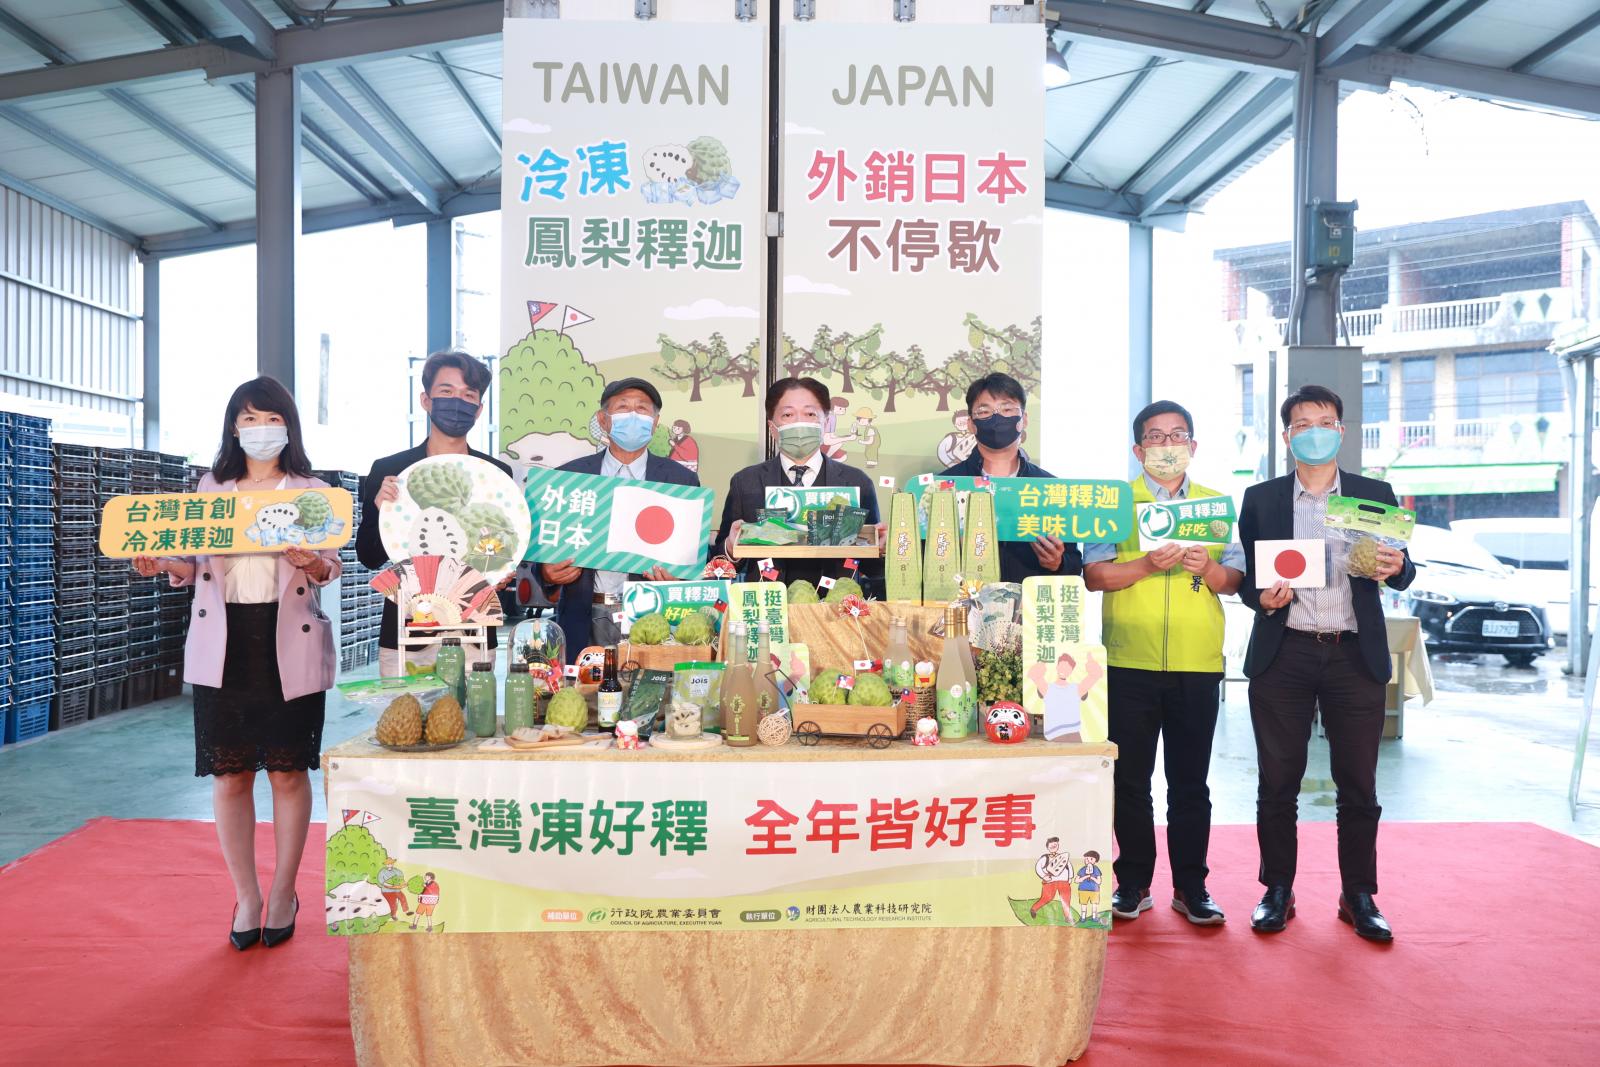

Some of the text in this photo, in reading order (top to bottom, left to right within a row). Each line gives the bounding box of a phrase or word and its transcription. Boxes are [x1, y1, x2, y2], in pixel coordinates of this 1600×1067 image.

[533, 61, 729, 105] TAIWAN
[831, 64, 995, 107] JAPAN
[517, 140, 631, 202] 冷凍
[806, 150, 1028, 204] 外銷日本
[524, 216, 743, 271] 鳳梨釋迦
[828, 219, 1001, 272] 不停歇
[126, 496, 236, 523] 台灣首創
[540, 484, 597, 516] 外銷
[1018, 483, 1119, 509] 台灣釋迦
[1179, 502, 1227, 520] 買釋迦
[121, 526, 234, 552] 冷凍釋迦
[537, 519, 593, 550] 日本
[1017, 514, 1118, 538] 美味しい
[1178, 522, 1208, 537] 好吃
[668, 586, 720, 602] 買釋迦
[1190, 575, 1204, 592] 署
[1036, 584, 1056, 663] 鳳梨釋迦
[1060, 584, 1080, 643] 挺臺灣
[406, 793, 1037, 857] 臺灣凍好釋 全年皆好事
[610, 907, 721, 919] 行政院農業委員會
[805, 902, 932, 915] 財團法人農業科技研究院
